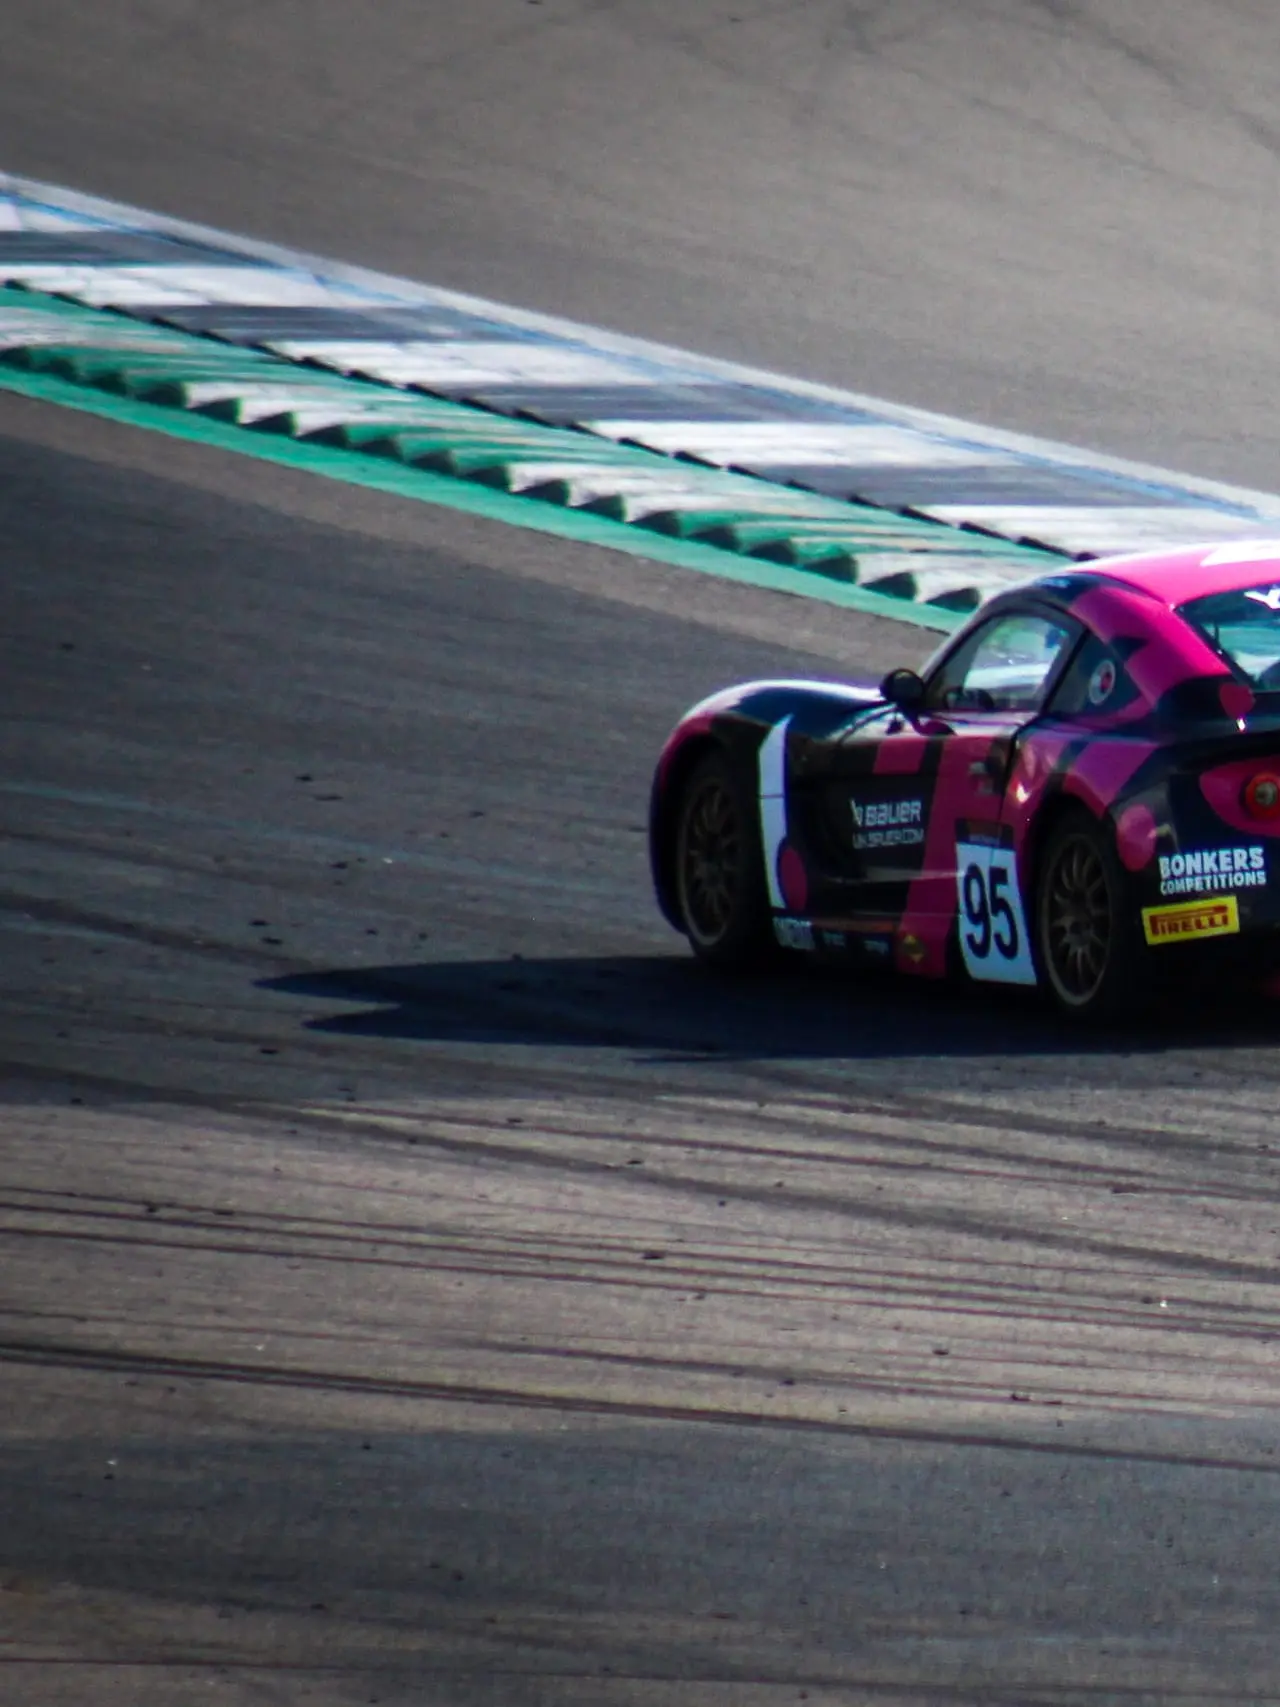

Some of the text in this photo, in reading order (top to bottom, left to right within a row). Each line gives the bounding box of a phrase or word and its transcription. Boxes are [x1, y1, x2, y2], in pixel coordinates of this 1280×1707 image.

[1158, 846, 1265, 879] BONKERS
[1160, 870, 1267, 895] COMPETITIONS
[963, 862, 1019, 960] 95
[1149, 904, 1229, 937] PIRELLI
